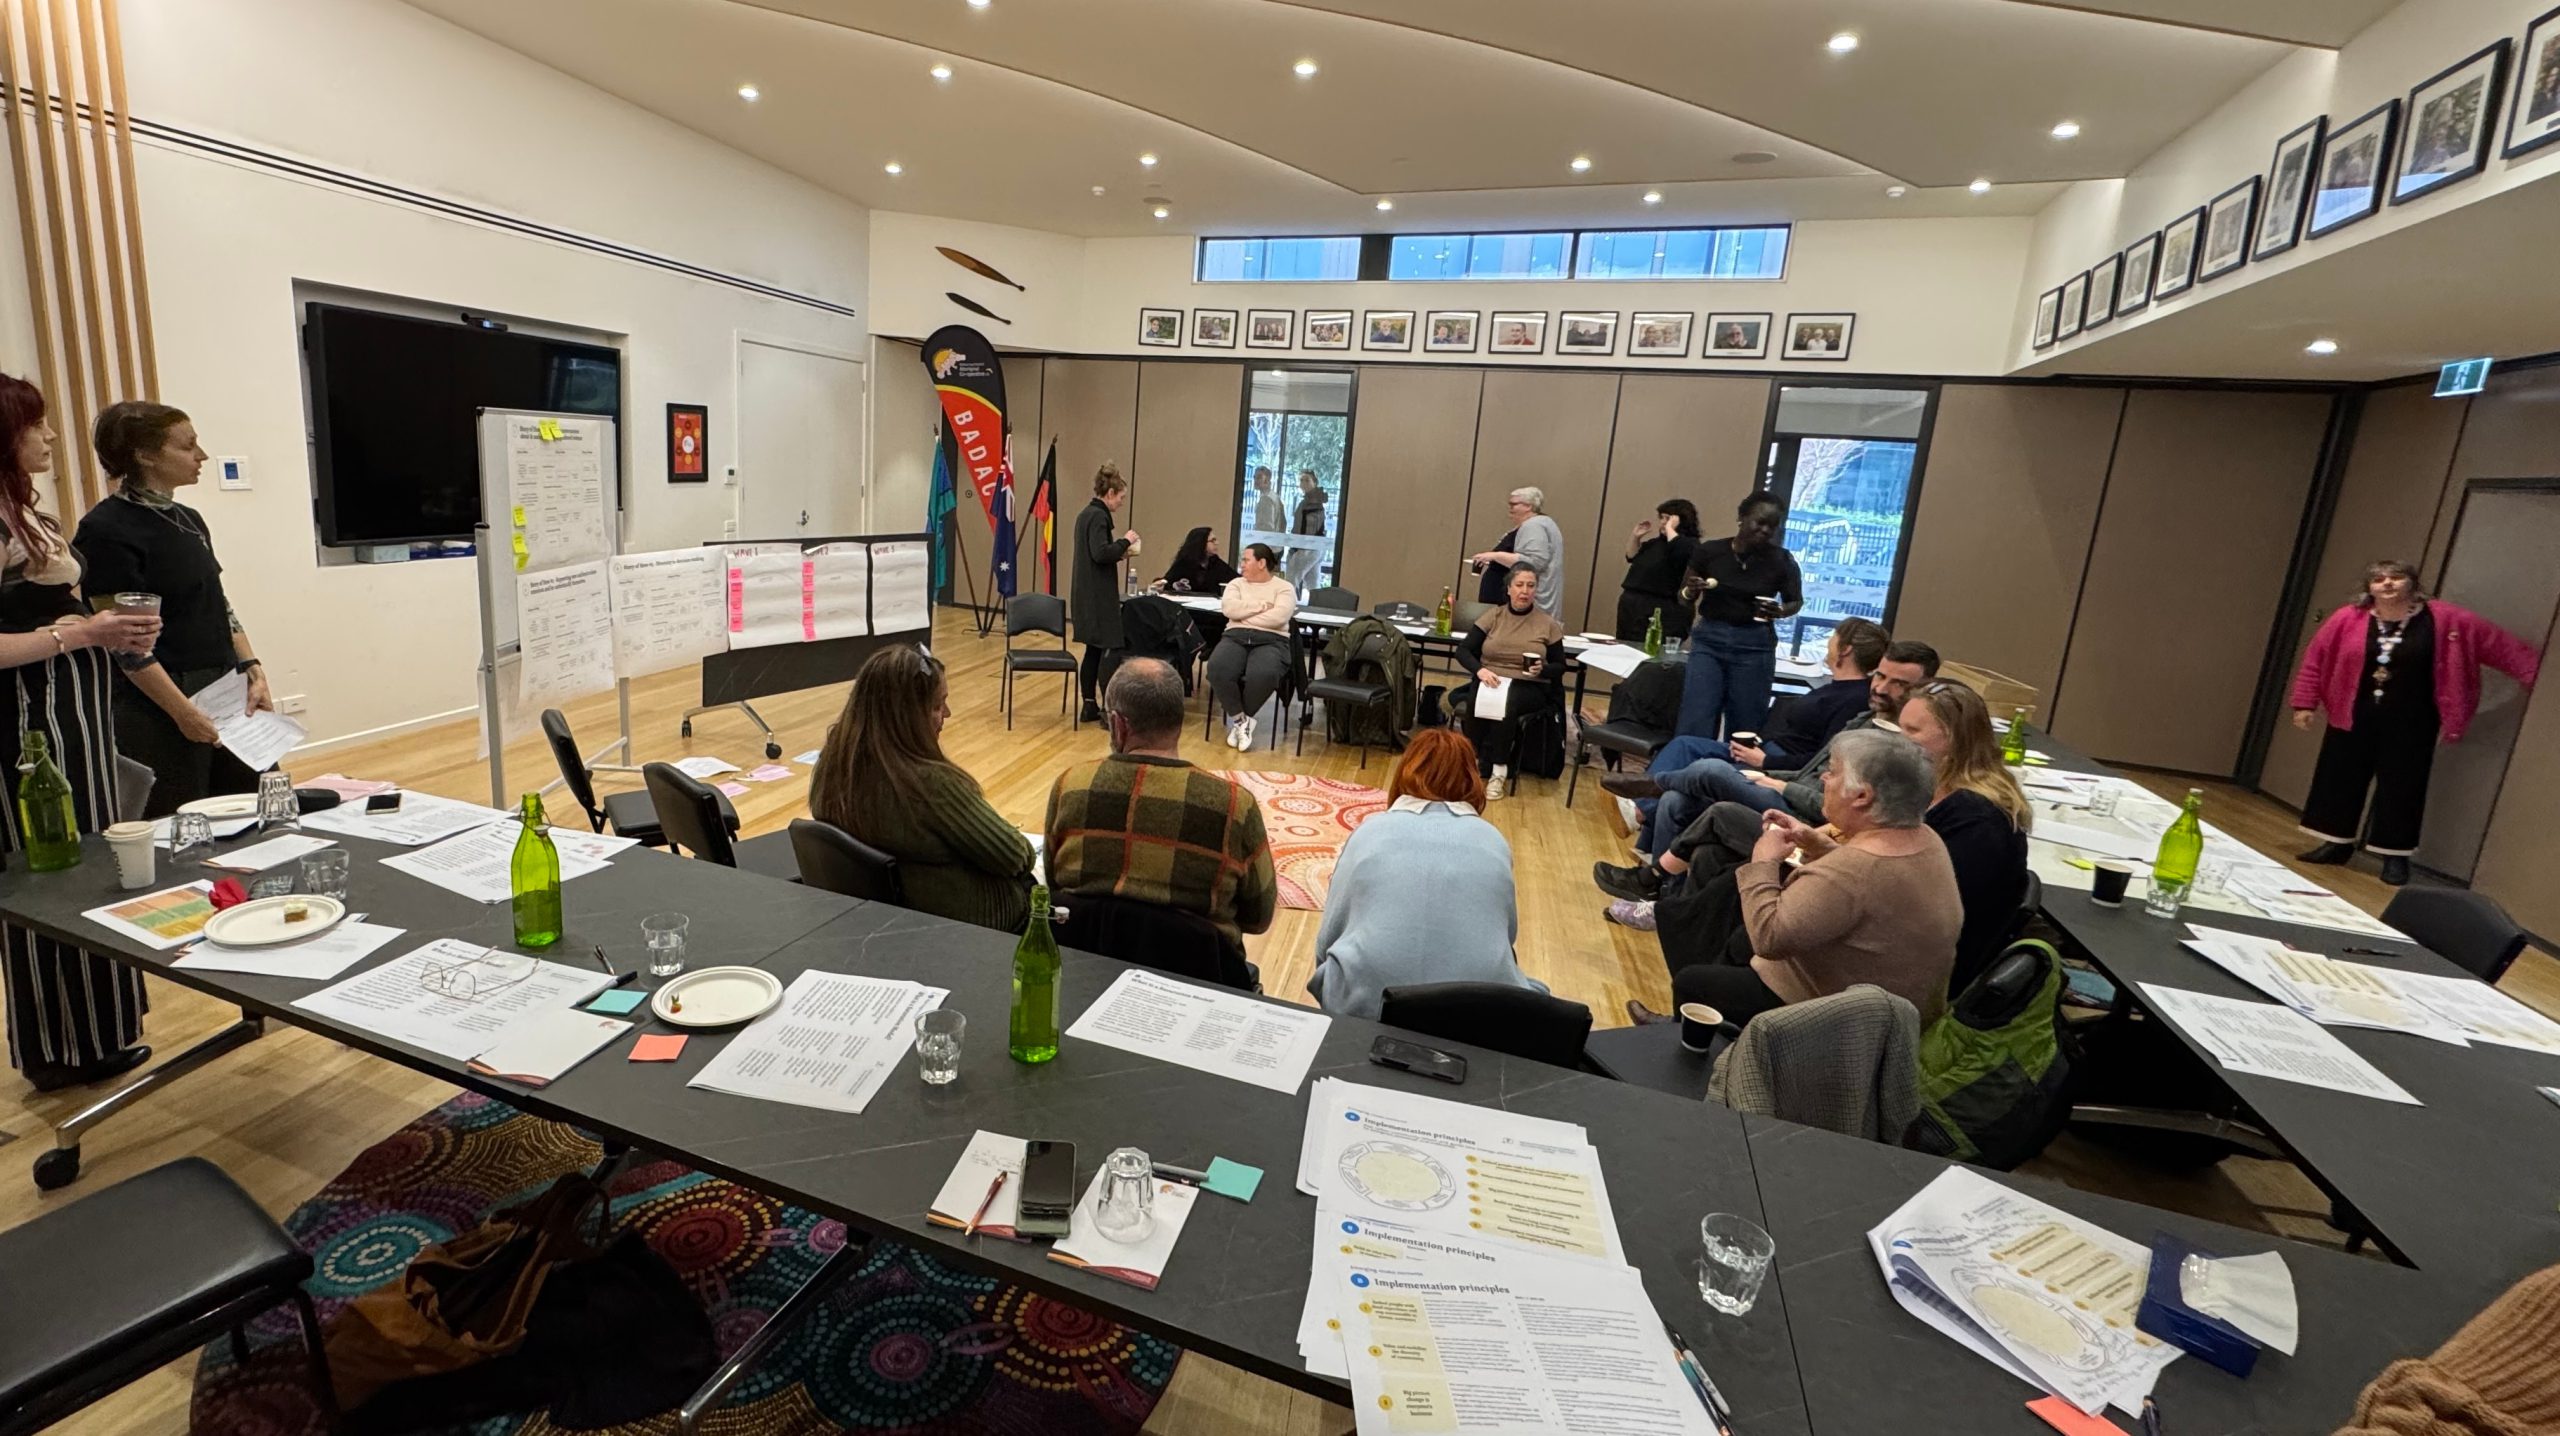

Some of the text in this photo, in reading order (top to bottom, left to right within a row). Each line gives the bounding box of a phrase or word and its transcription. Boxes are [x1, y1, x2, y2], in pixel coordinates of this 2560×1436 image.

[955, 410, 996, 496] BADAC
[1364, 1117, 1432, 1136] Implementation
[1433, 1131, 1476, 1146] principles
[1364, 1228, 1496, 1262] Implementation principles
[1374, 1278, 1510, 1295] Implementation principles
